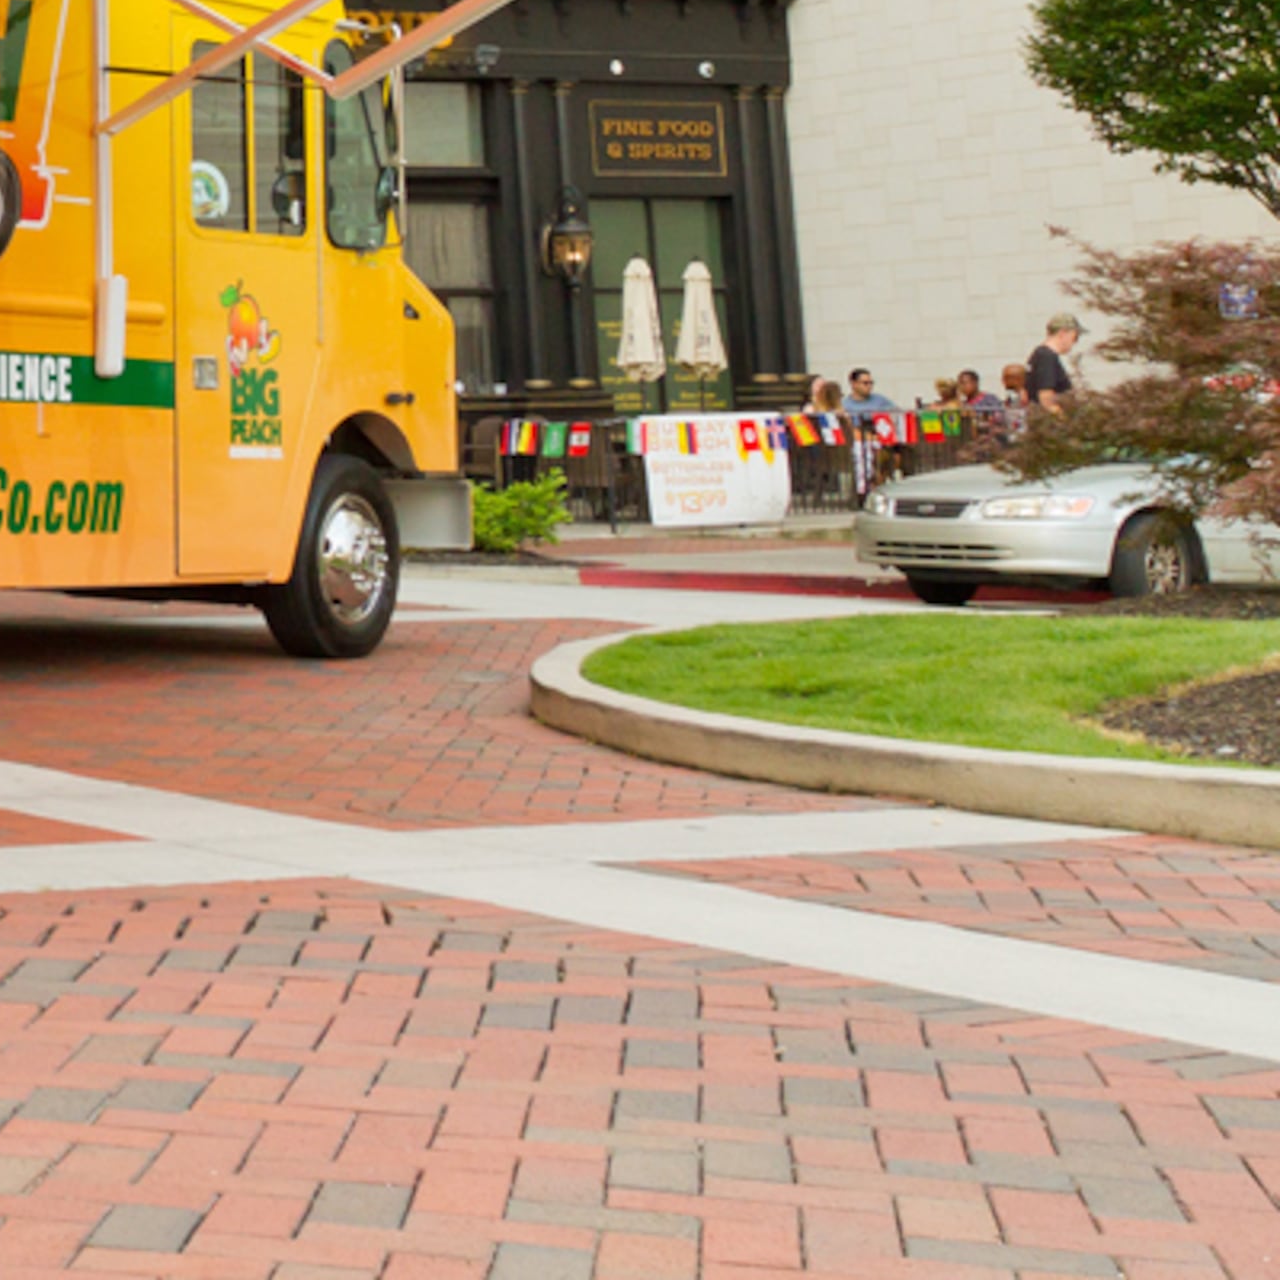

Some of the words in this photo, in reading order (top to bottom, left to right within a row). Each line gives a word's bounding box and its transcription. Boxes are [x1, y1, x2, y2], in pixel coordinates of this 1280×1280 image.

[602, 119, 654, 136] FINE
[658, 120, 714, 137] FOOD
[628, 142, 712, 160] SPIRITS
[231, 368, 280, 416] BIG
[231, 419, 282, 445] PEACH
